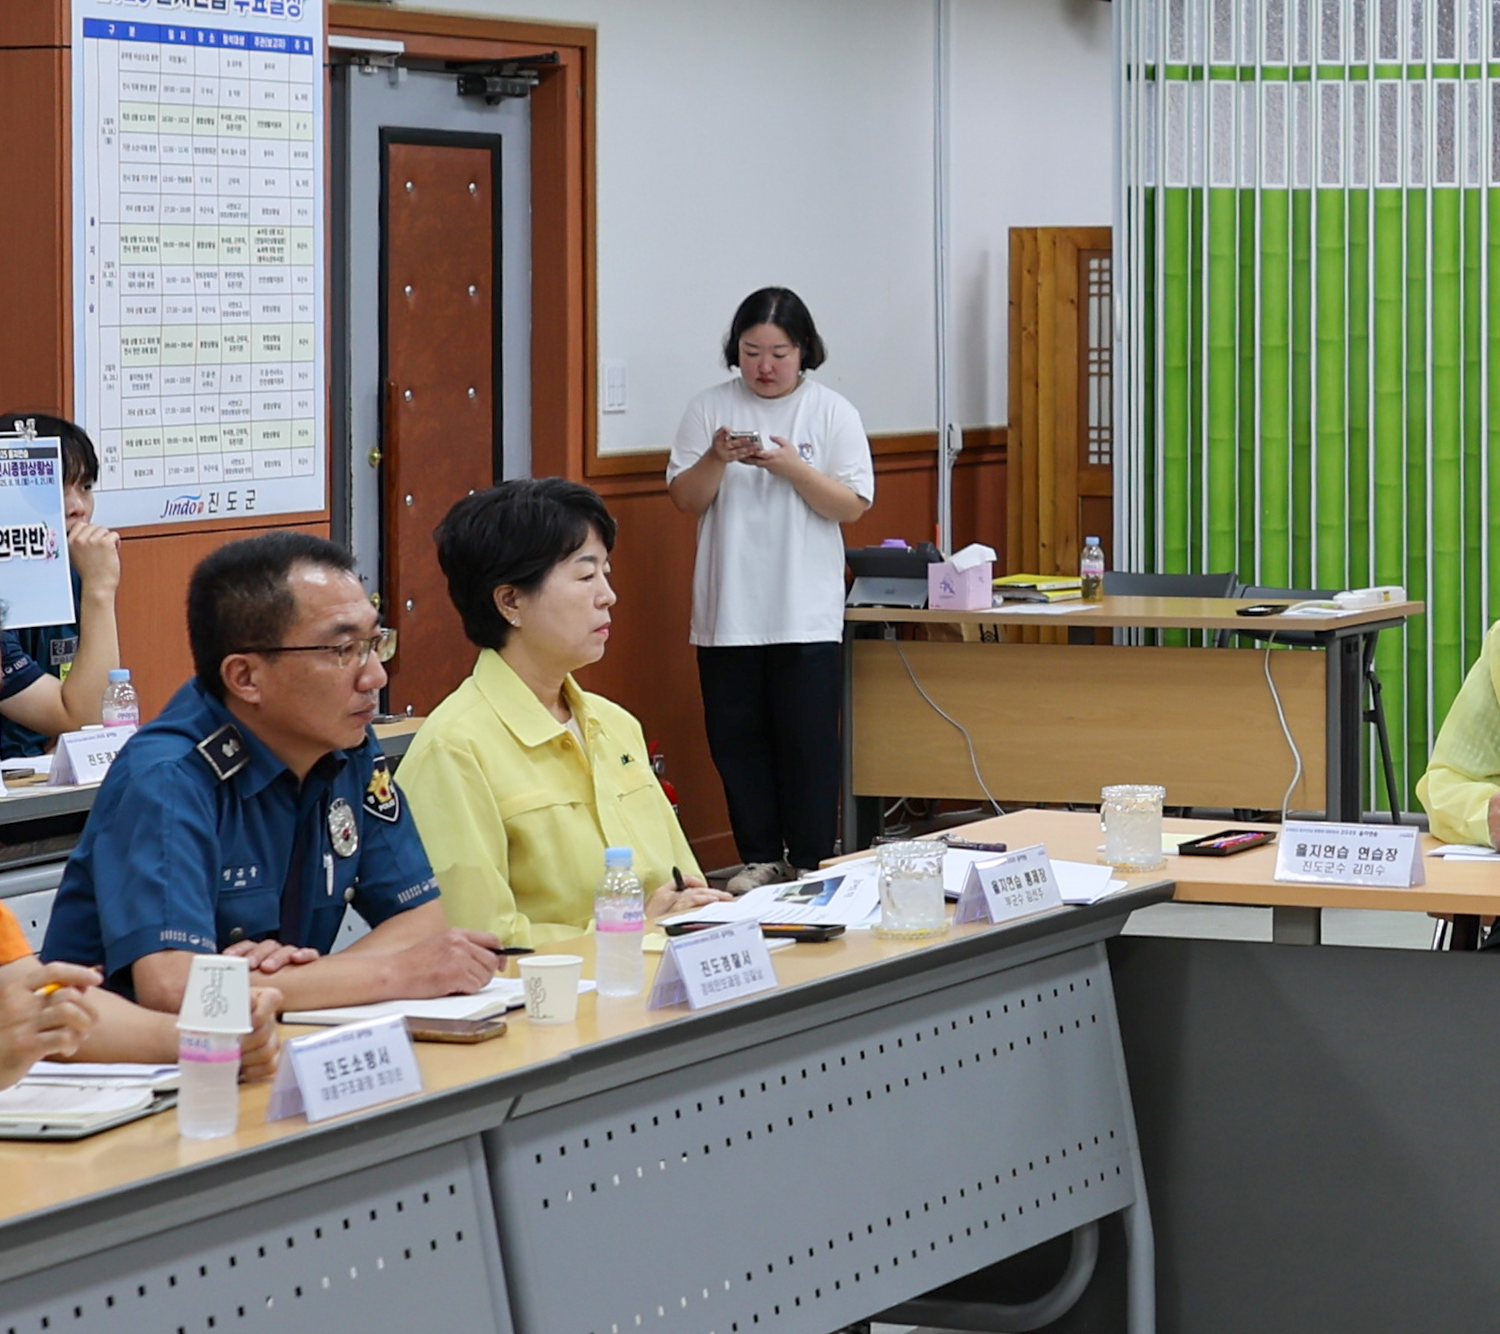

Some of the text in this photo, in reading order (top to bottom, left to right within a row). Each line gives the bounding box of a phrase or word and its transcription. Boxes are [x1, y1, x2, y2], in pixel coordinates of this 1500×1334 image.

[160, 495, 198, 518] Jindo
[1296, 843, 1398, 862] 을지연습 연습장
[1302, 860, 1385, 876] 진도군수 김희수
[991, 868, 1047, 894] 을지연습 통제장
[700, 950, 752, 977] 진도경찰서
[324, 1046, 390, 1080] 진도소방서
